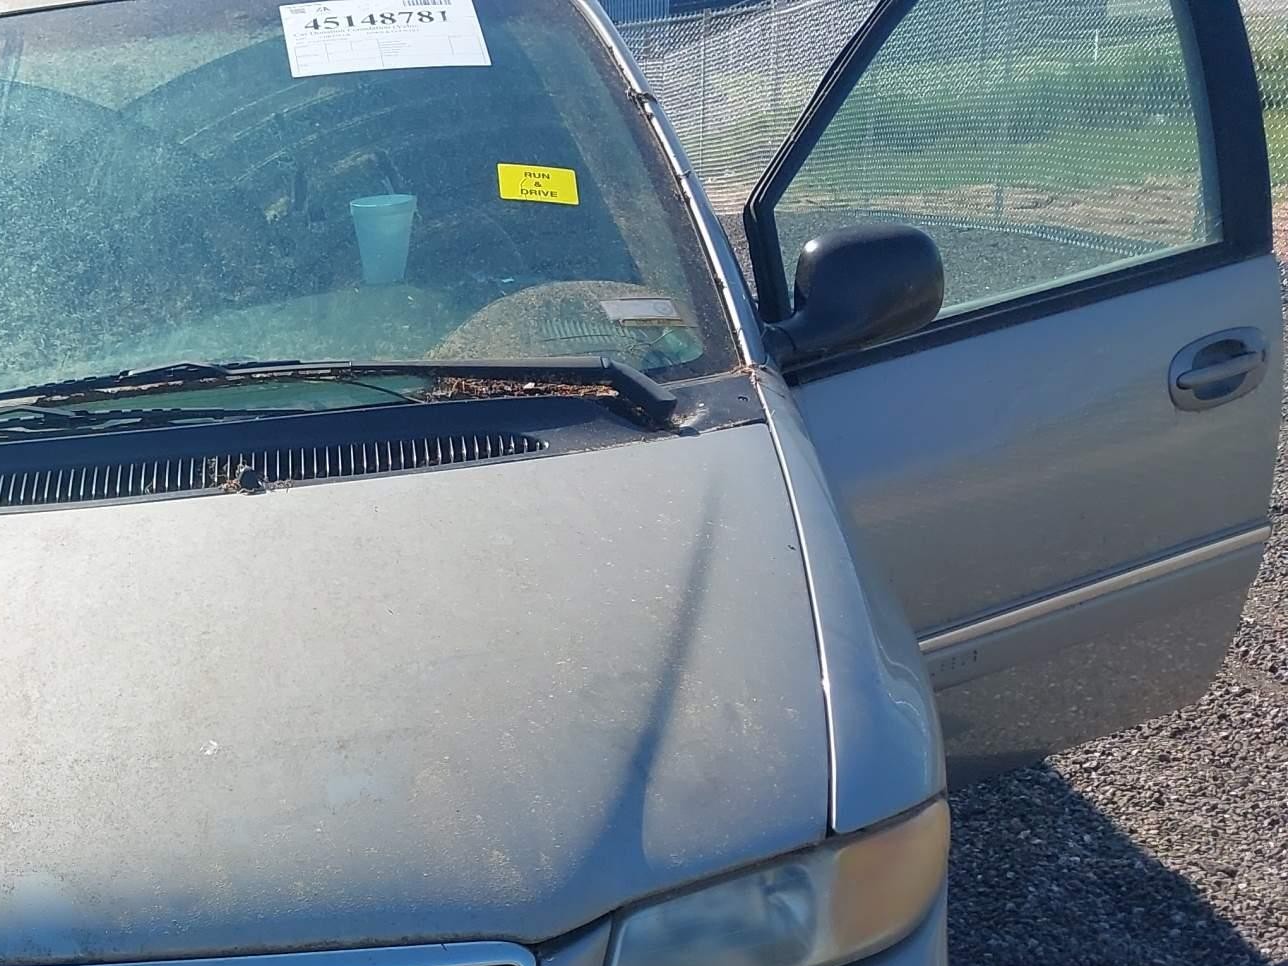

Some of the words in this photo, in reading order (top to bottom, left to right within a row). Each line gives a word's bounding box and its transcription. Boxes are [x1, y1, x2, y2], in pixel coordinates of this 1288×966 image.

[304, 11, 449, 31] 45148781
[524, 171, 551, 180] RUN
[520, 188, 558, 198] DRIVE
